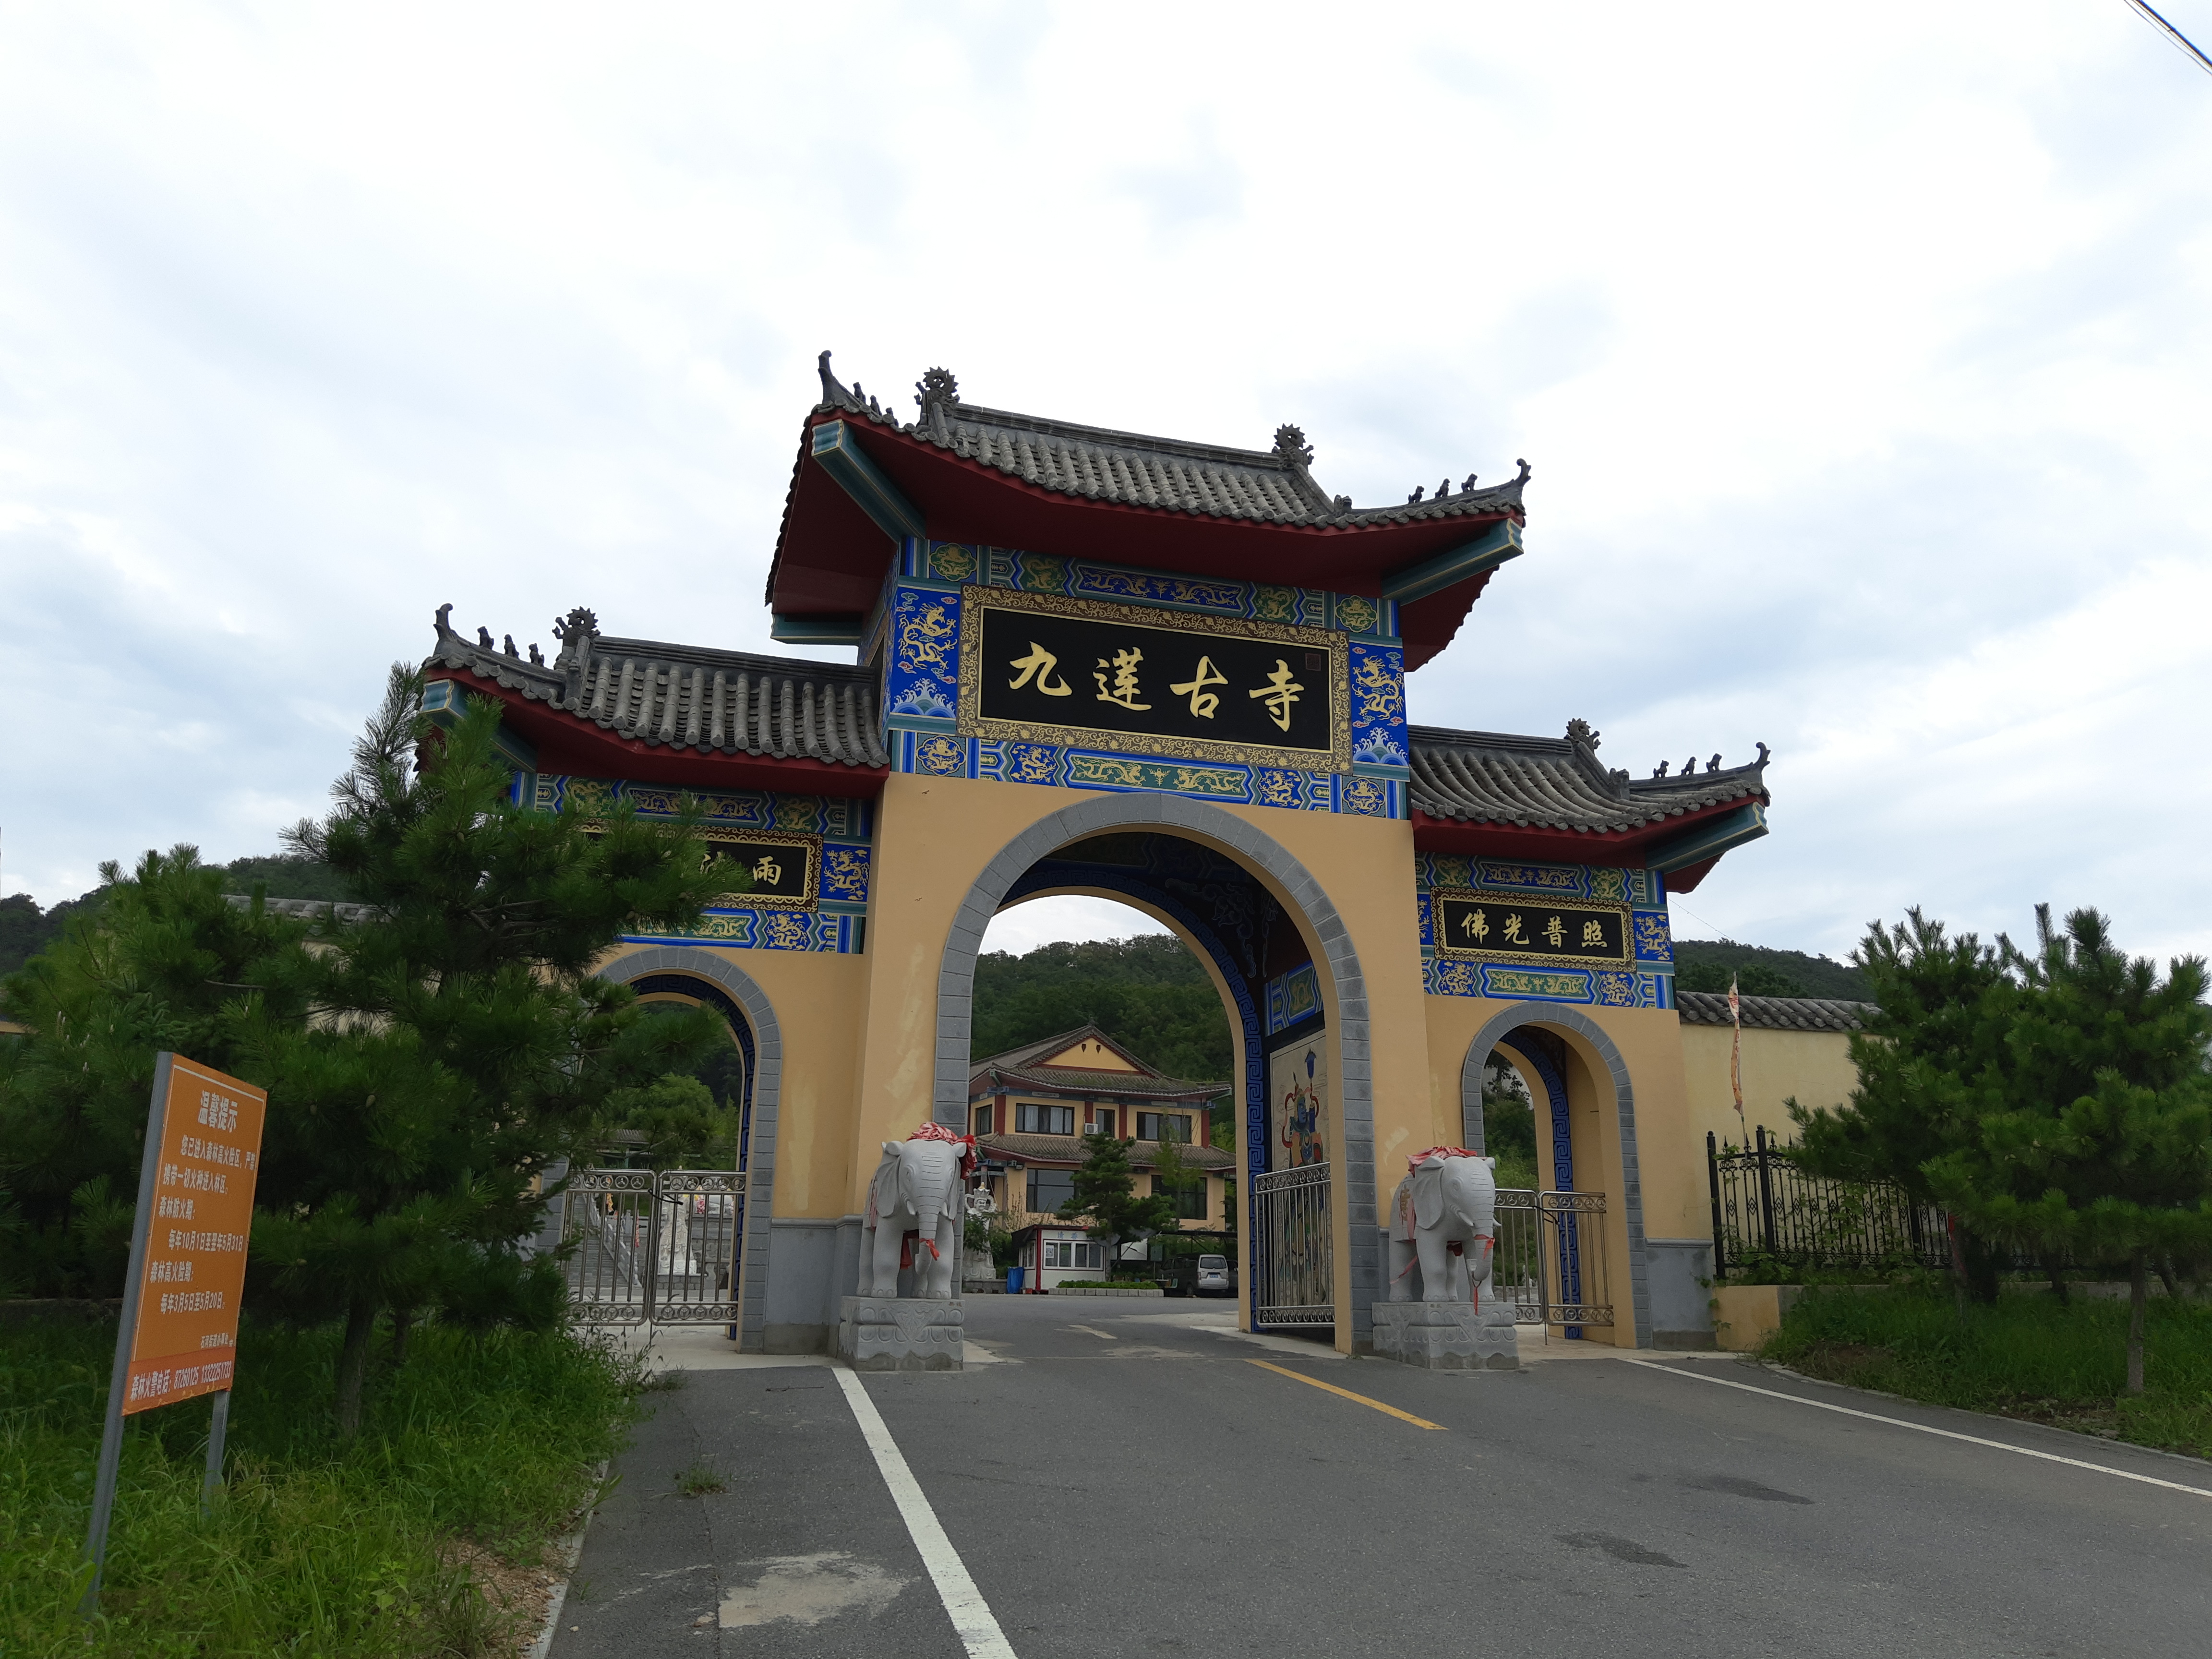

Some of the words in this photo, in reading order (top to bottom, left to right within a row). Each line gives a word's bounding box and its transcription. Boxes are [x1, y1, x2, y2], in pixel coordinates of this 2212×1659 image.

[1461, 908, 1608, 949] 佛光普照
[198, 1090, 238, 1133] 温馨提示
[180, 1134, 255, 1171] 您已进入森林高火险区，严禁
[163, 1162, 228, 1195] 携带一切火种进入林区。
[158, 1195, 195, 1220] 森林防火期：
[168, 1228, 243, 1252] 每年10月1日至翌年5月31日
[149, 1260, 194, 1283] 森林高火险期：
[161, 1291, 225, 1315] 每年3月5日至5月20日。
